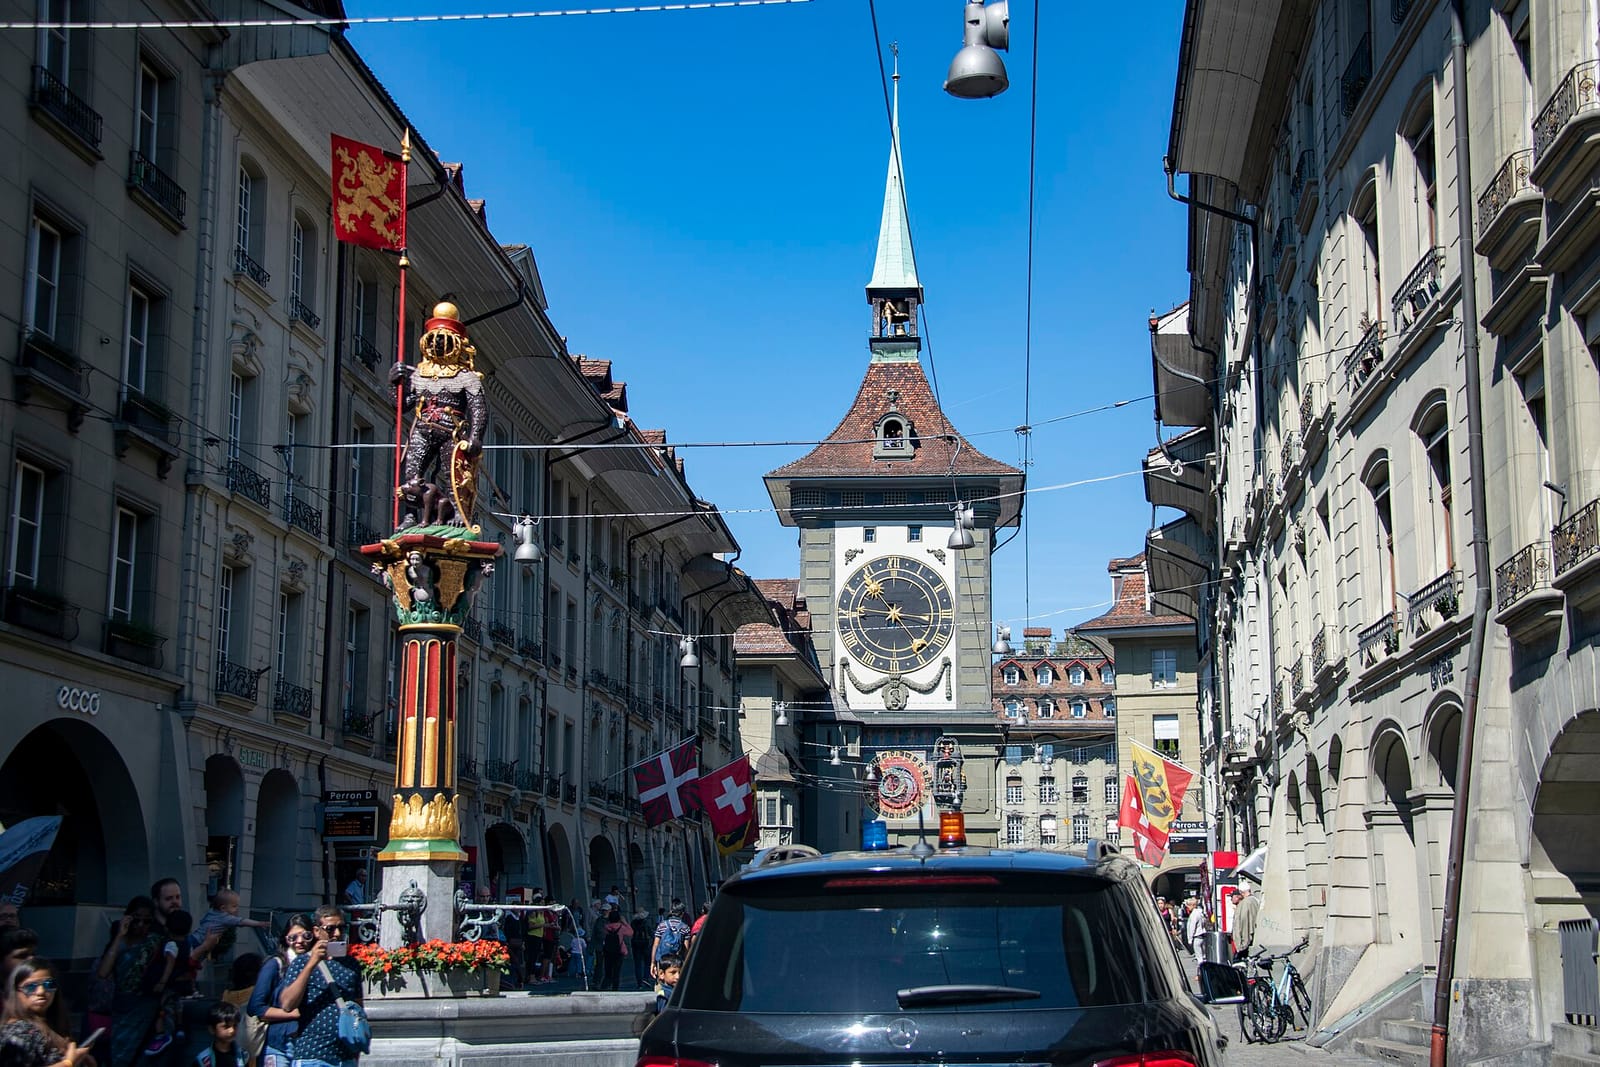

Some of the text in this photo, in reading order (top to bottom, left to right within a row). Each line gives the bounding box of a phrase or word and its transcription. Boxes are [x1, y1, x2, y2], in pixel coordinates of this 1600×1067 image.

[58, 685, 101, 716] ecco
[330, 791, 372, 800] Perron D
